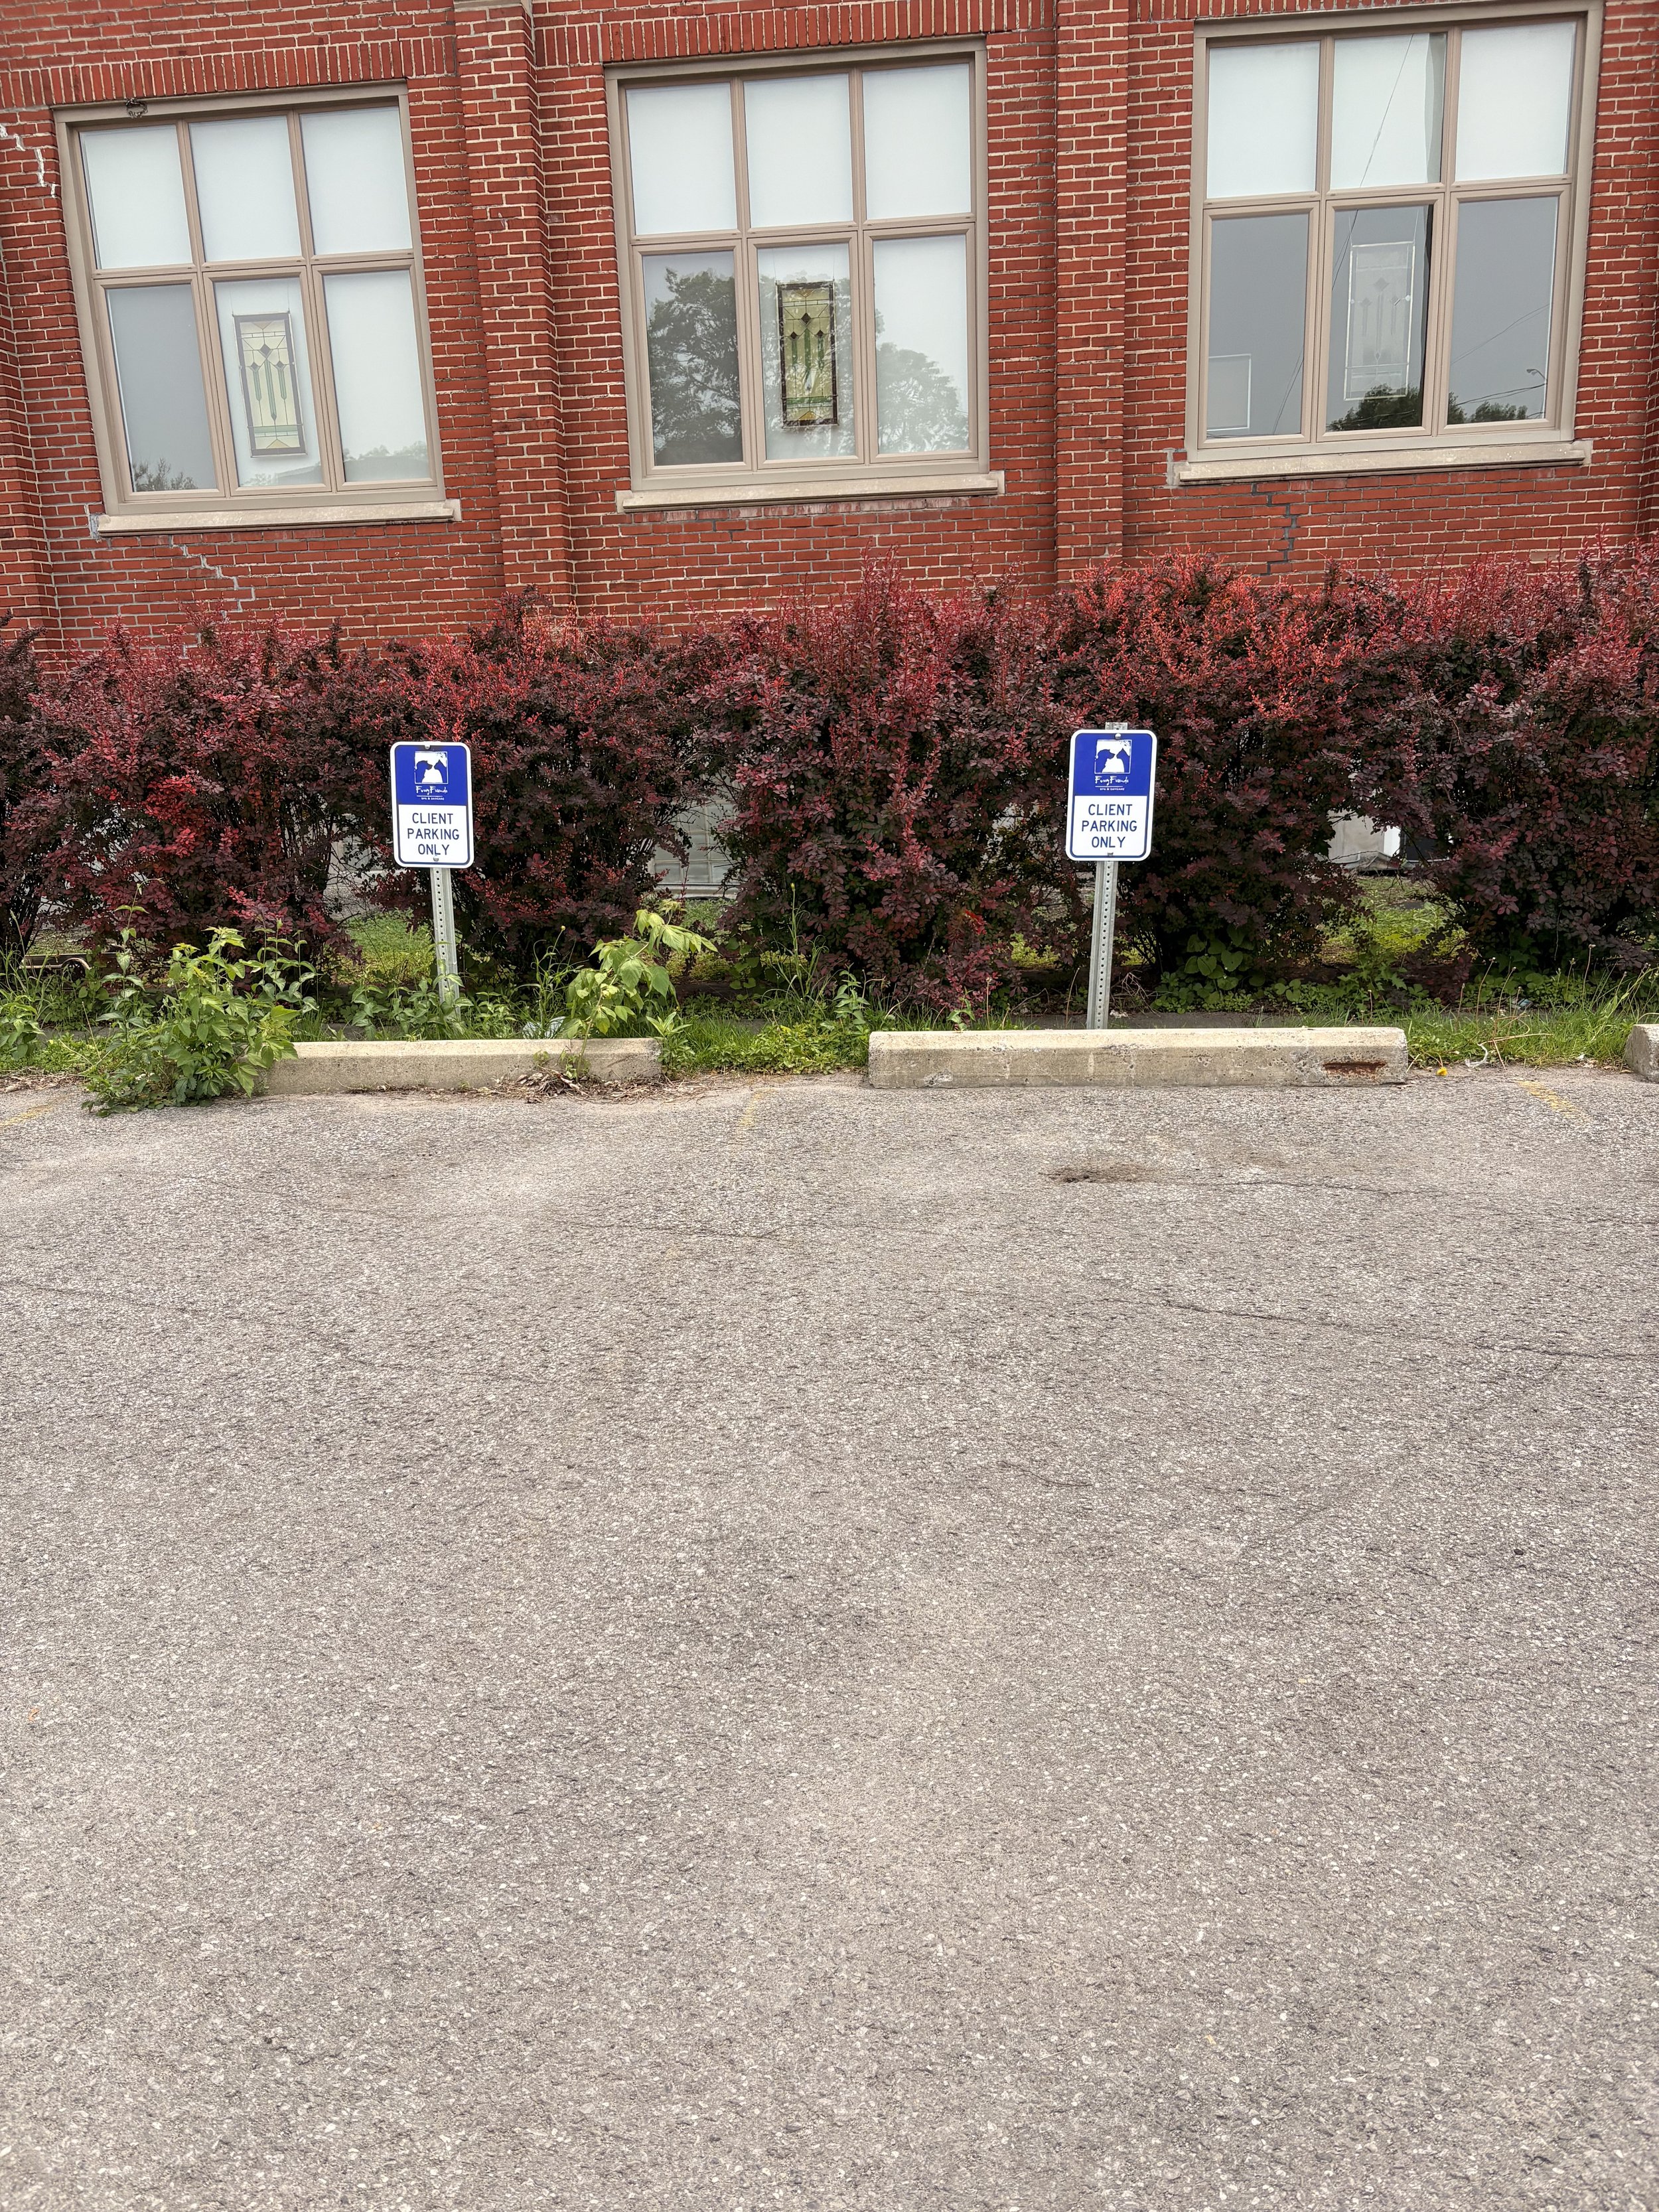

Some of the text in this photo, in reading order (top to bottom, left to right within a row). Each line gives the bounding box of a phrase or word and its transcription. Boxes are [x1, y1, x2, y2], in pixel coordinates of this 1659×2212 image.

[1088, 804, 1133, 816] CLIENT
[412, 813, 453, 824] CLIENT
[1082, 820, 1137, 832] PARKING
[407, 828, 459, 840] PARKING
[1092, 836, 1125, 848] ONLY
[418, 844, 449, 855] ONLY
